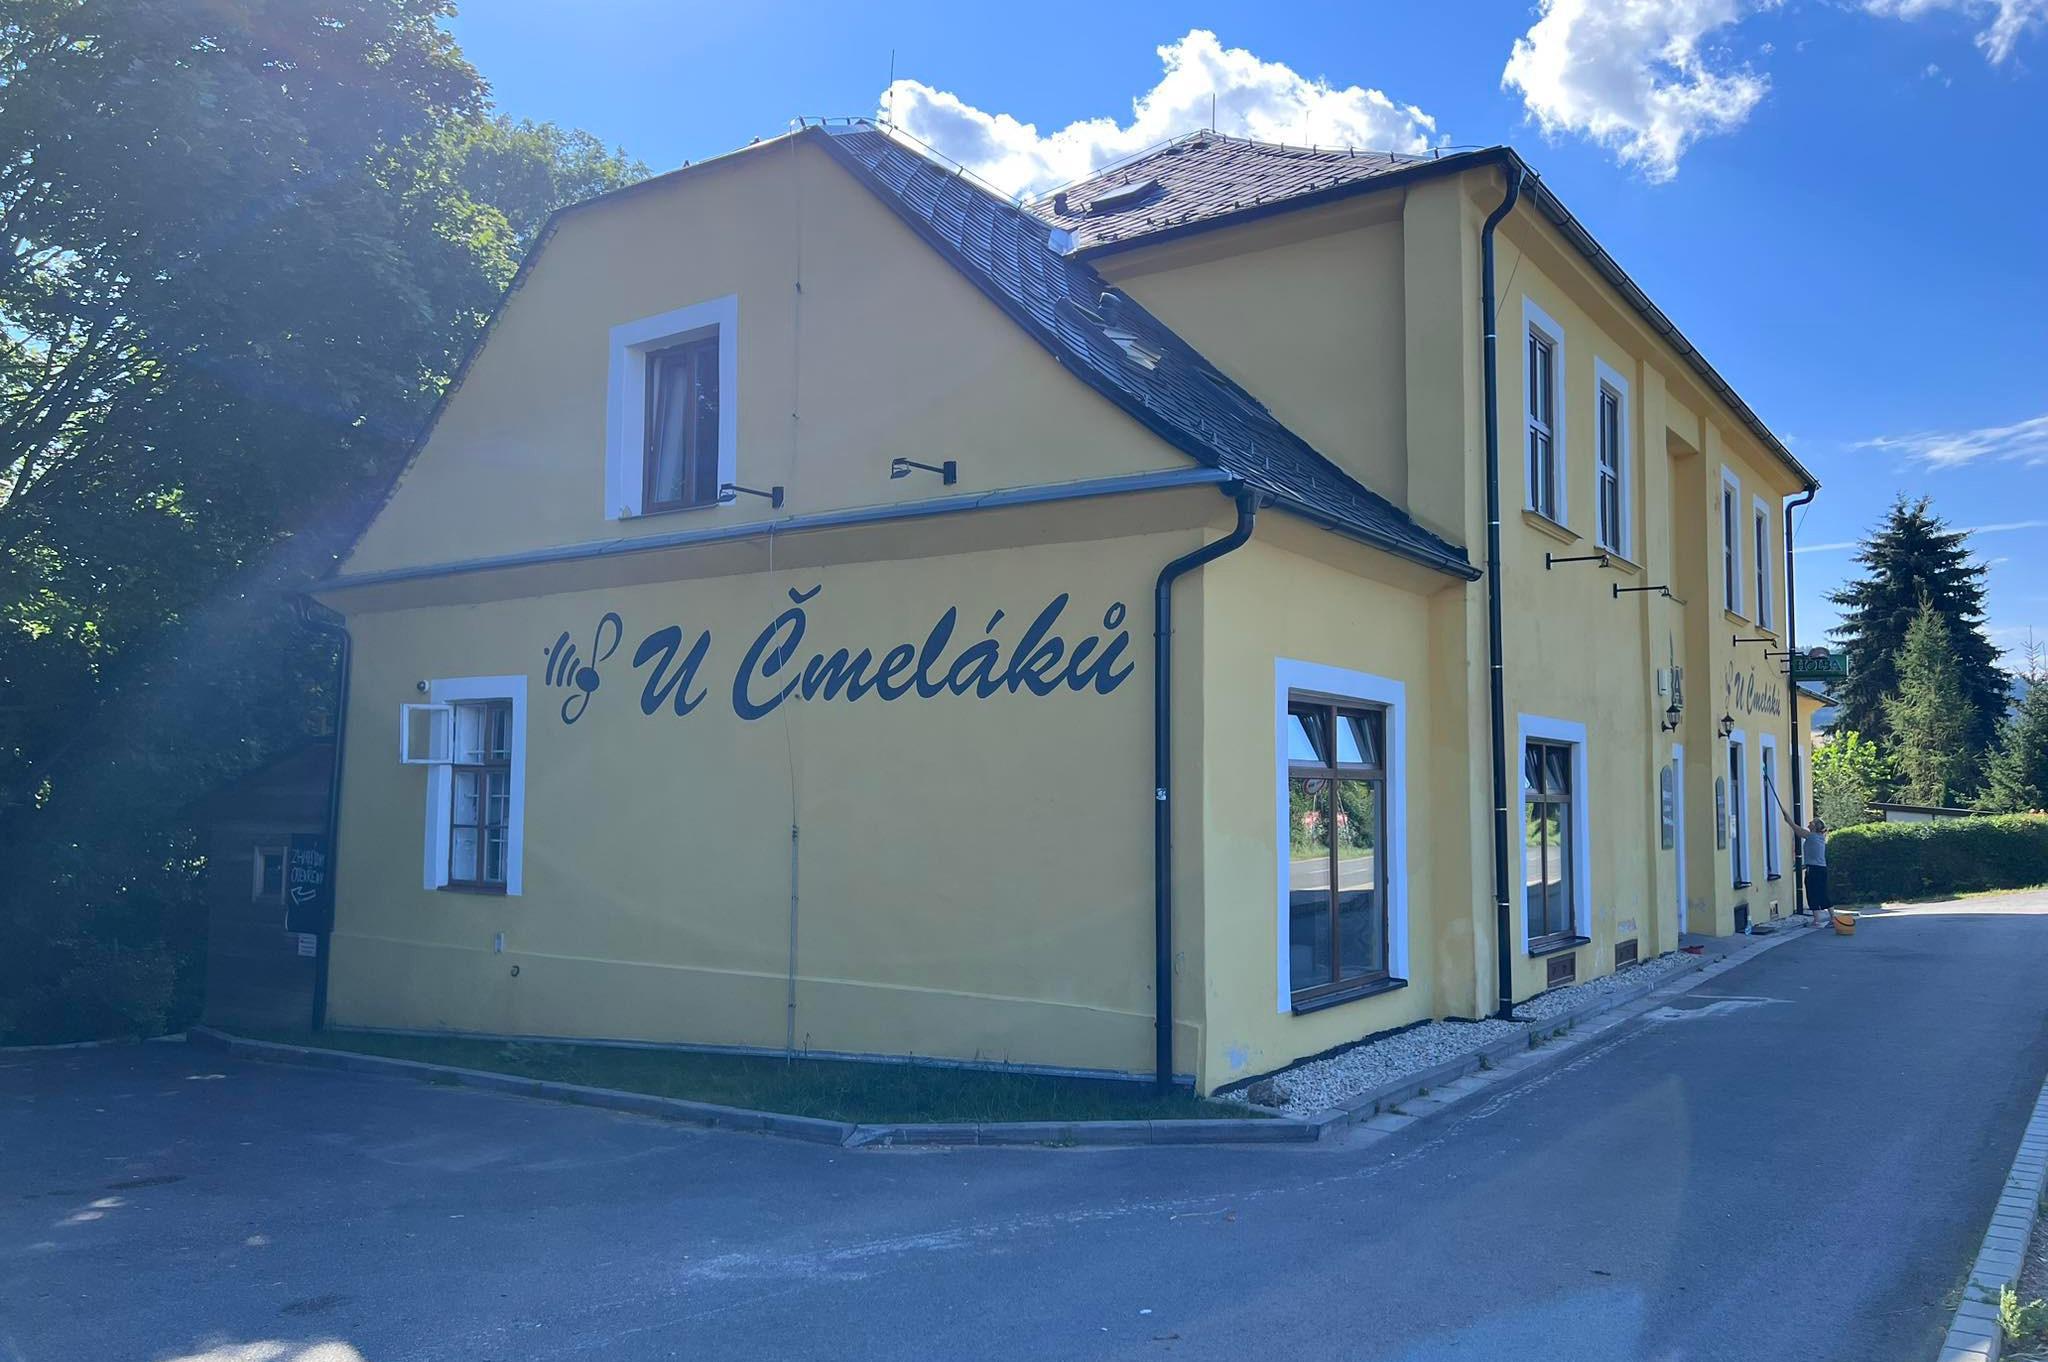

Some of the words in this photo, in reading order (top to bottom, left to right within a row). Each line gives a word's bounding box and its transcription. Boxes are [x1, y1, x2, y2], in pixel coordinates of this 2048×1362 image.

[633, 625, 711, 716] U
[732, 584, 1135, 721] Čmeláků
[1796, 659, 1842, 671] HOLBA
[1734, 671, 1744, 711] U
